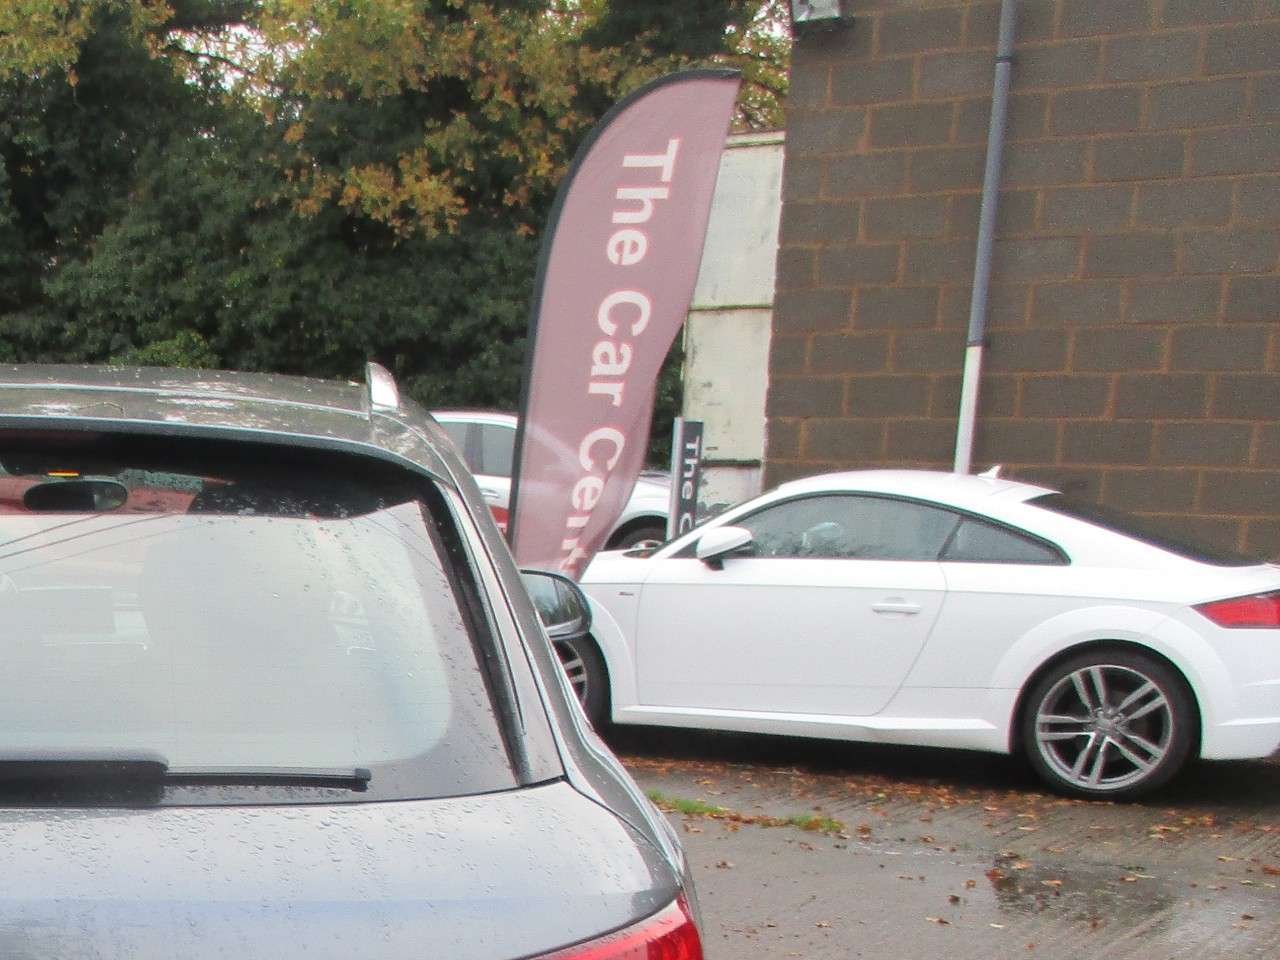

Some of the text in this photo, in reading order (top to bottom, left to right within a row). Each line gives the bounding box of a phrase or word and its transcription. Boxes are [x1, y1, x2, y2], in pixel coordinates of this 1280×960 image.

[607, 137, 682, 267] The
[586, 288, 652, 408] Car
[681, 434, 700, 500] The
